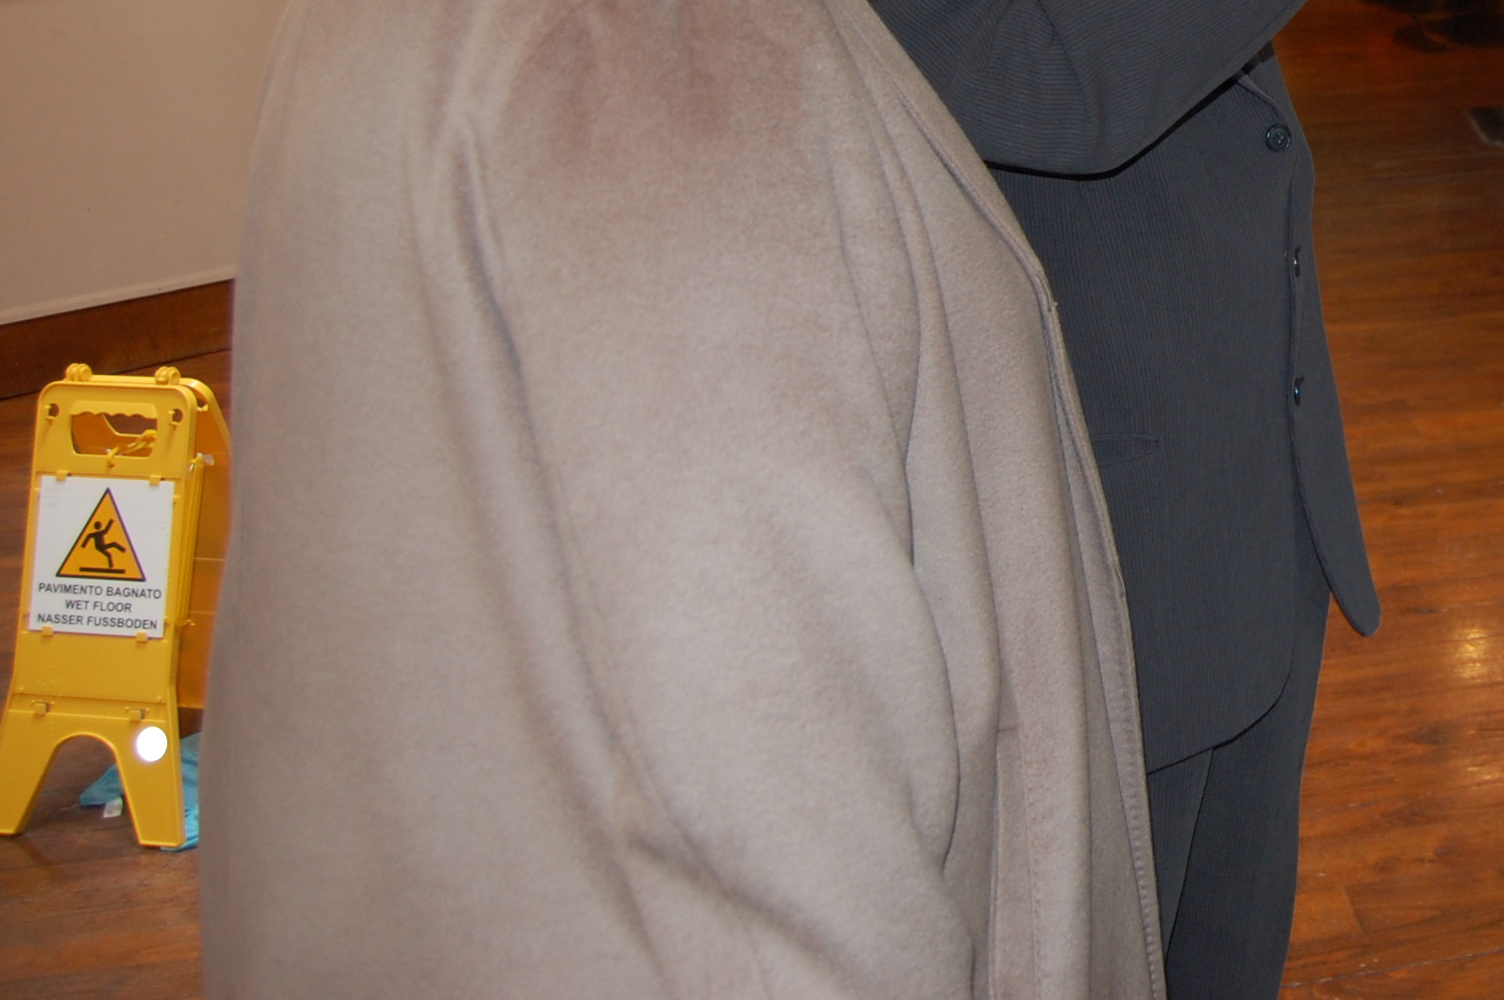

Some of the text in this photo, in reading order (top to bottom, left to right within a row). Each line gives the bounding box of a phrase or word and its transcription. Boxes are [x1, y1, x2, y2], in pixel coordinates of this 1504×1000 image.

[38, 582, 162, 599] PAVIMENTO BAGNATO
[65, 600, 132, 612] WET FLOOR
[38, 613, 157, 629] NASSER FUSSBODEN
